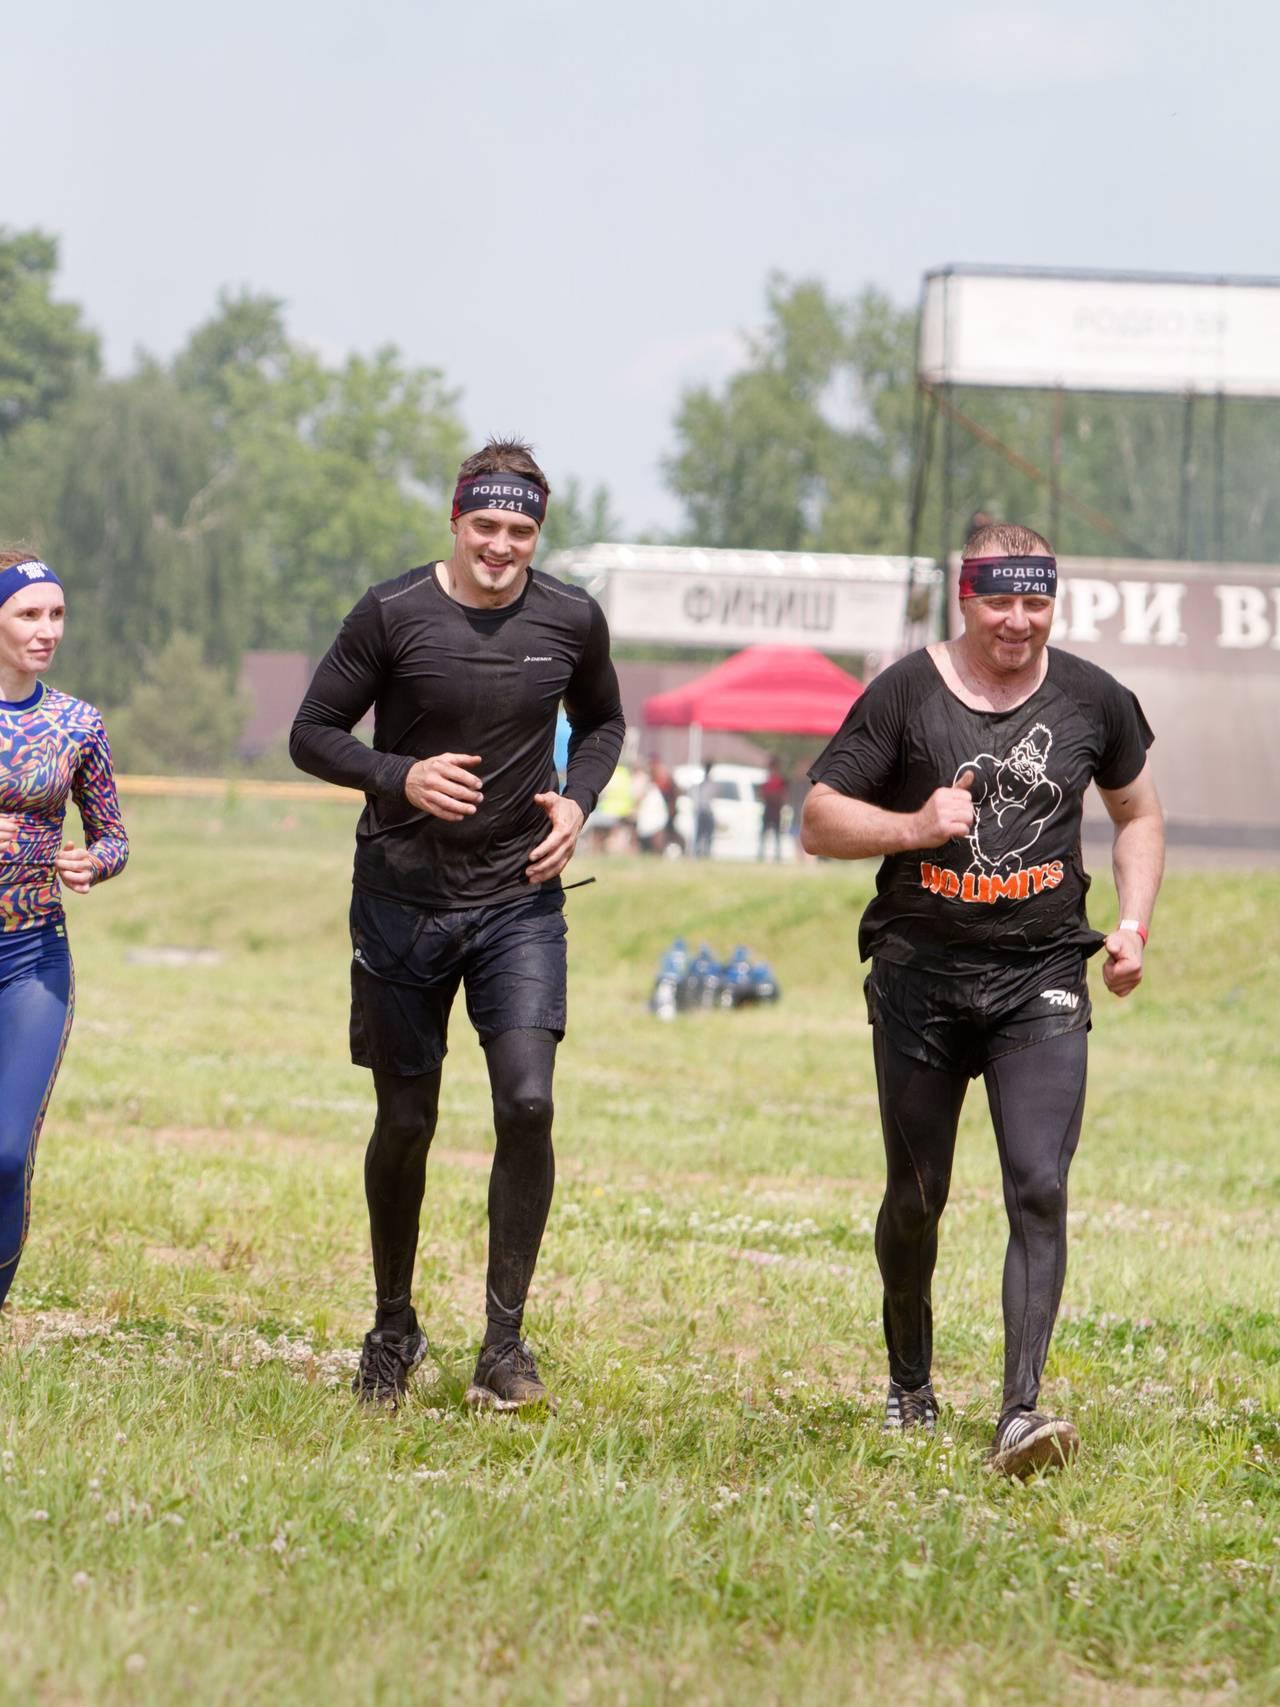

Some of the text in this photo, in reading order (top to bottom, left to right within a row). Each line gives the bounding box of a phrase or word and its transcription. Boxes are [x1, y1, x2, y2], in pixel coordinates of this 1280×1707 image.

[472, 485, 540, 503] РОДЕО 59
[488, 499, 523, 512] 2741
[992, 568, 1056, 579] РОДЕО 59
[1013, 582, 1047, 593] 2740
[683, 581, 836, 632] ФИНИШ
[1212, 583, 1280, 652] В
[920, 859, 1065, 905] NO LIMITS
